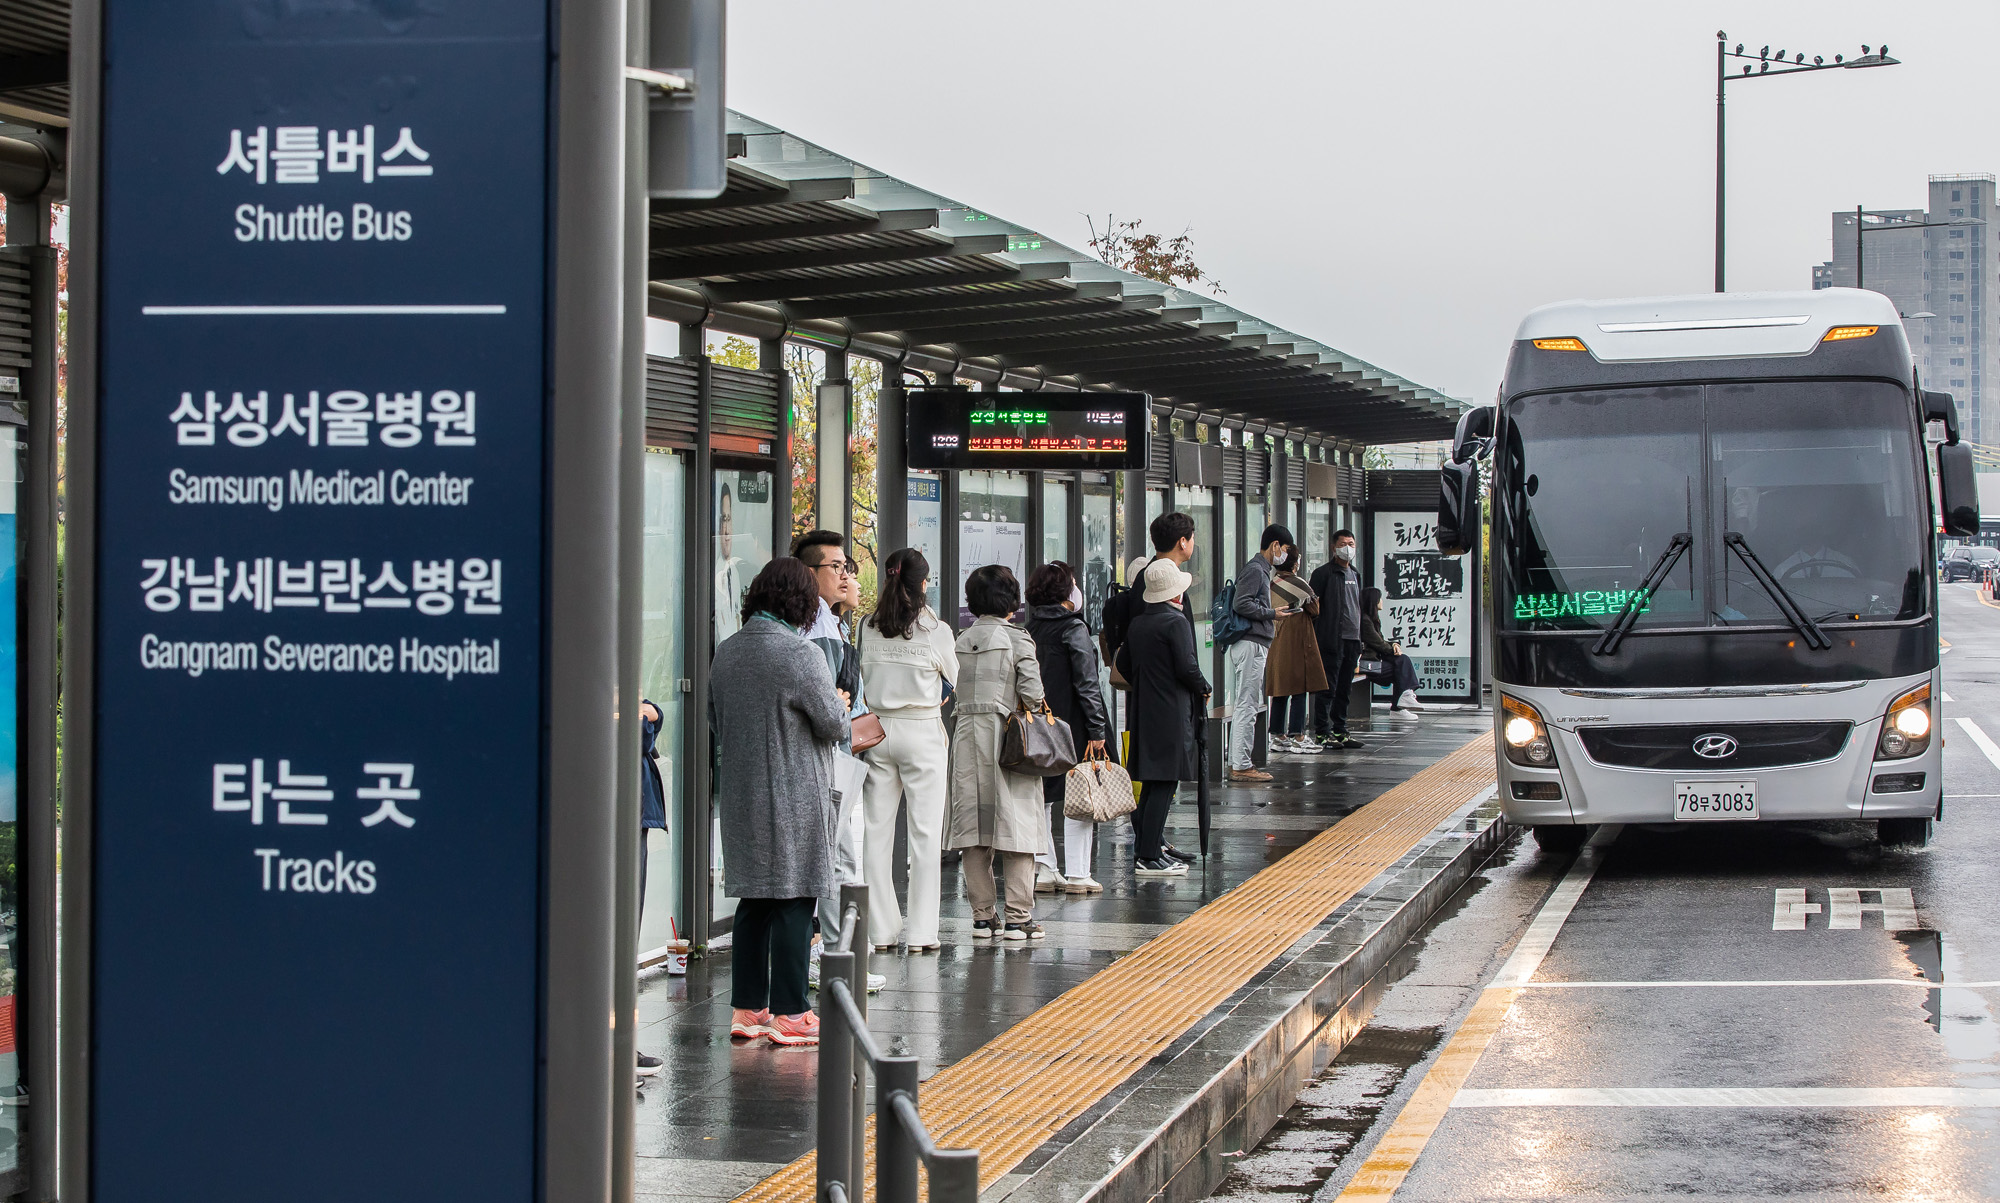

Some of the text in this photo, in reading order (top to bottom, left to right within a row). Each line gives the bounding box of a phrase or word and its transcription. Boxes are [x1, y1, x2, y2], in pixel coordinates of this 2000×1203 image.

[217, 124, 434, 185] 셔틀버스
[234, 203, 413, 241] Shuttle Bus
[169, 389, 477, 448] 삼성서울병원
[169, 469, 474, 512] Samsung Medical Center
[140, 556, 503, 616] 강남세브란스병원
[1396, 557, 1430, 577] 폐암
[1398, 574, 1452, 596] 폐질환
[140, 634, 500, 681] Gangnam Severance Hospital
[212, 758, 421, 829] 타는 곳
[254, 848, 377, 894] Tracks
